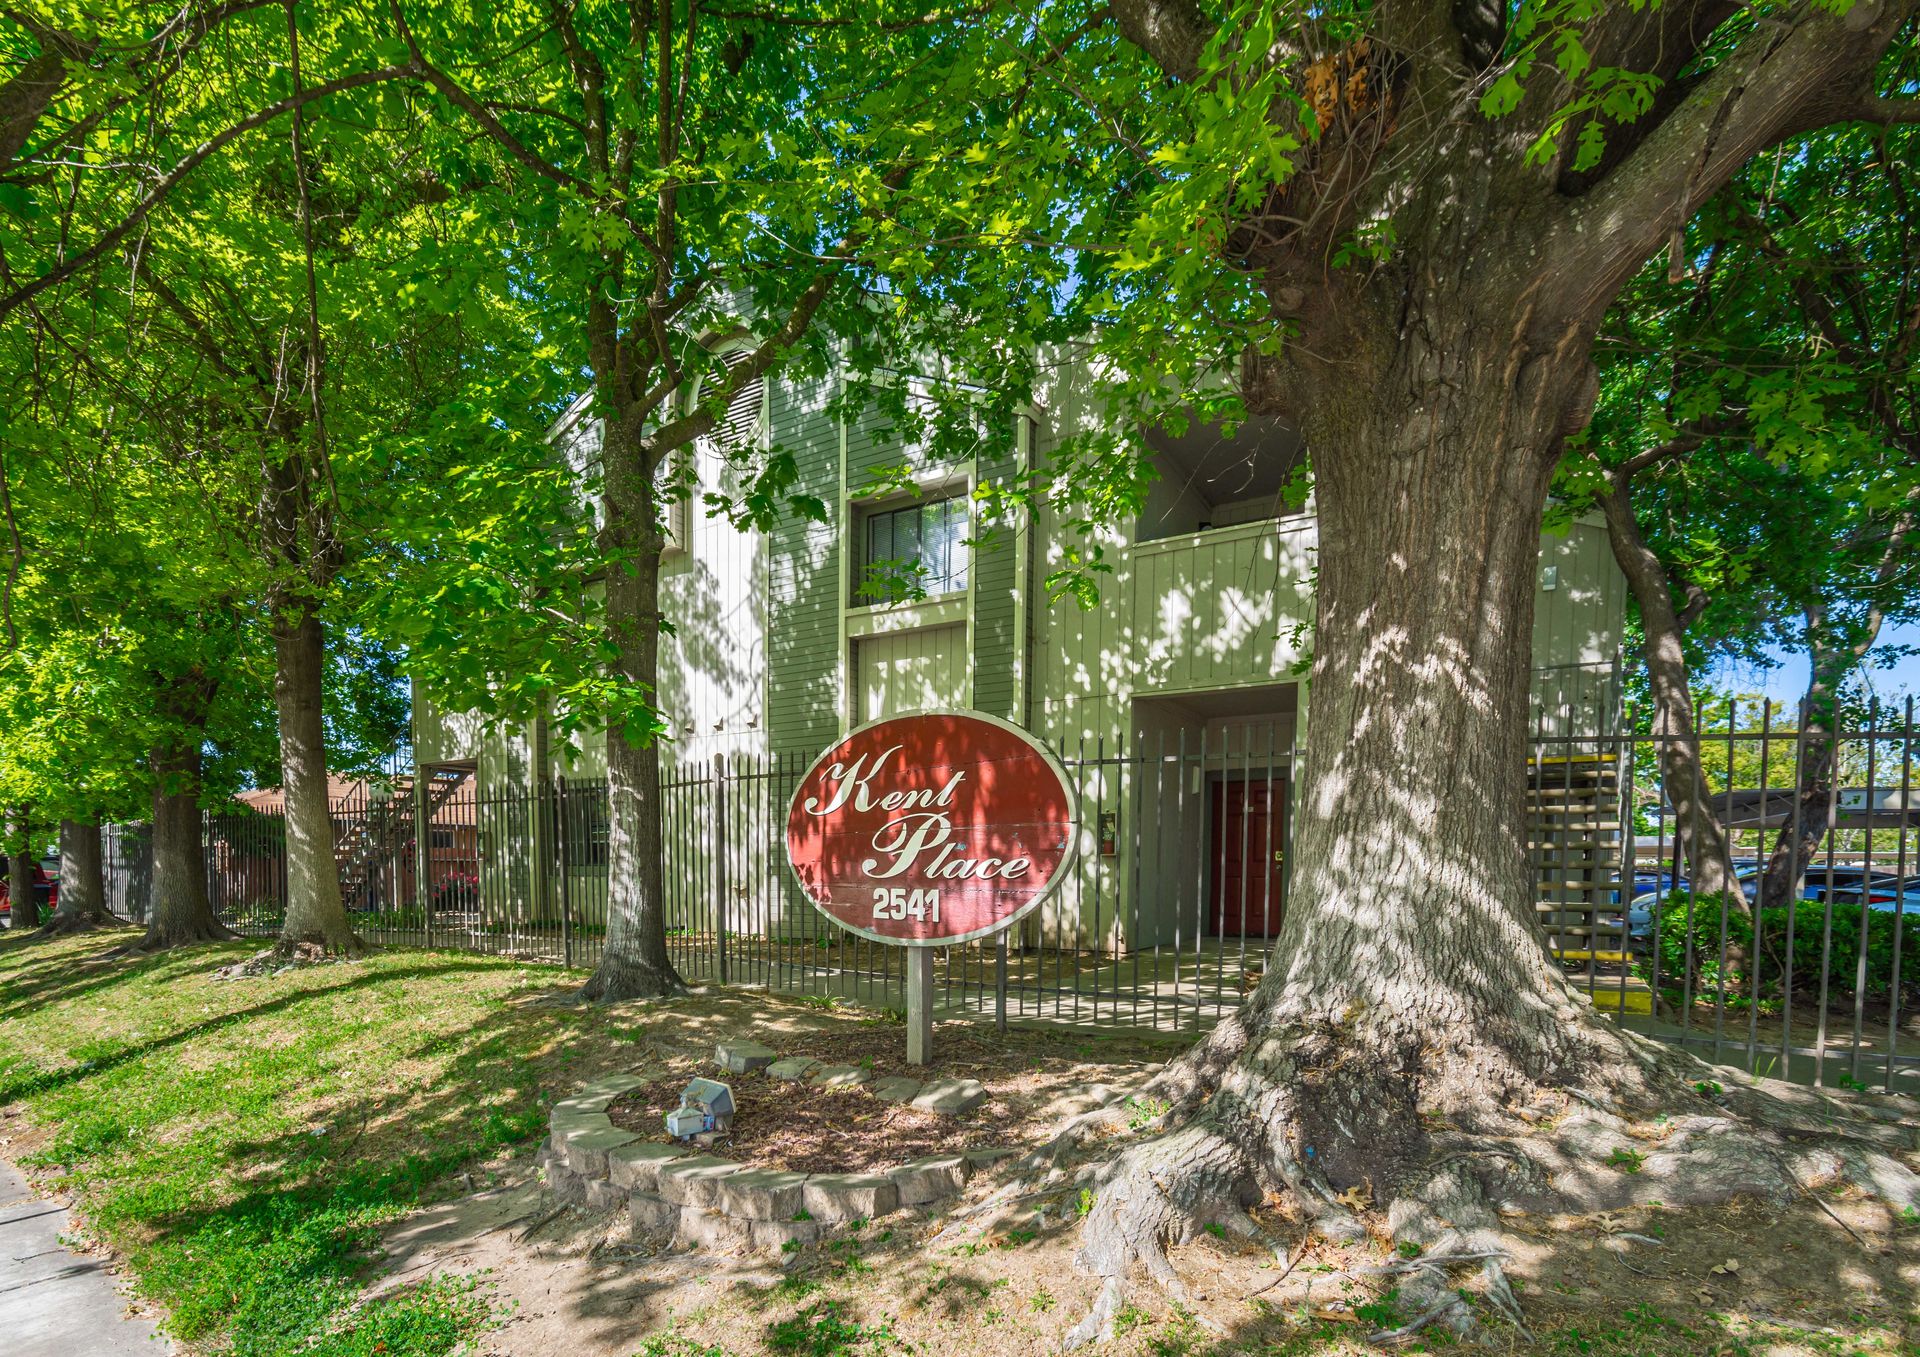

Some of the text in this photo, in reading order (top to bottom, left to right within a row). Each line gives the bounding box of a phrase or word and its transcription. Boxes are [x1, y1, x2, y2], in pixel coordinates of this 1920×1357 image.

[804, 744, 966, 816] Kent
[861, 811, 1031, 880] Place
[872, 887, 941, 923] 2541
